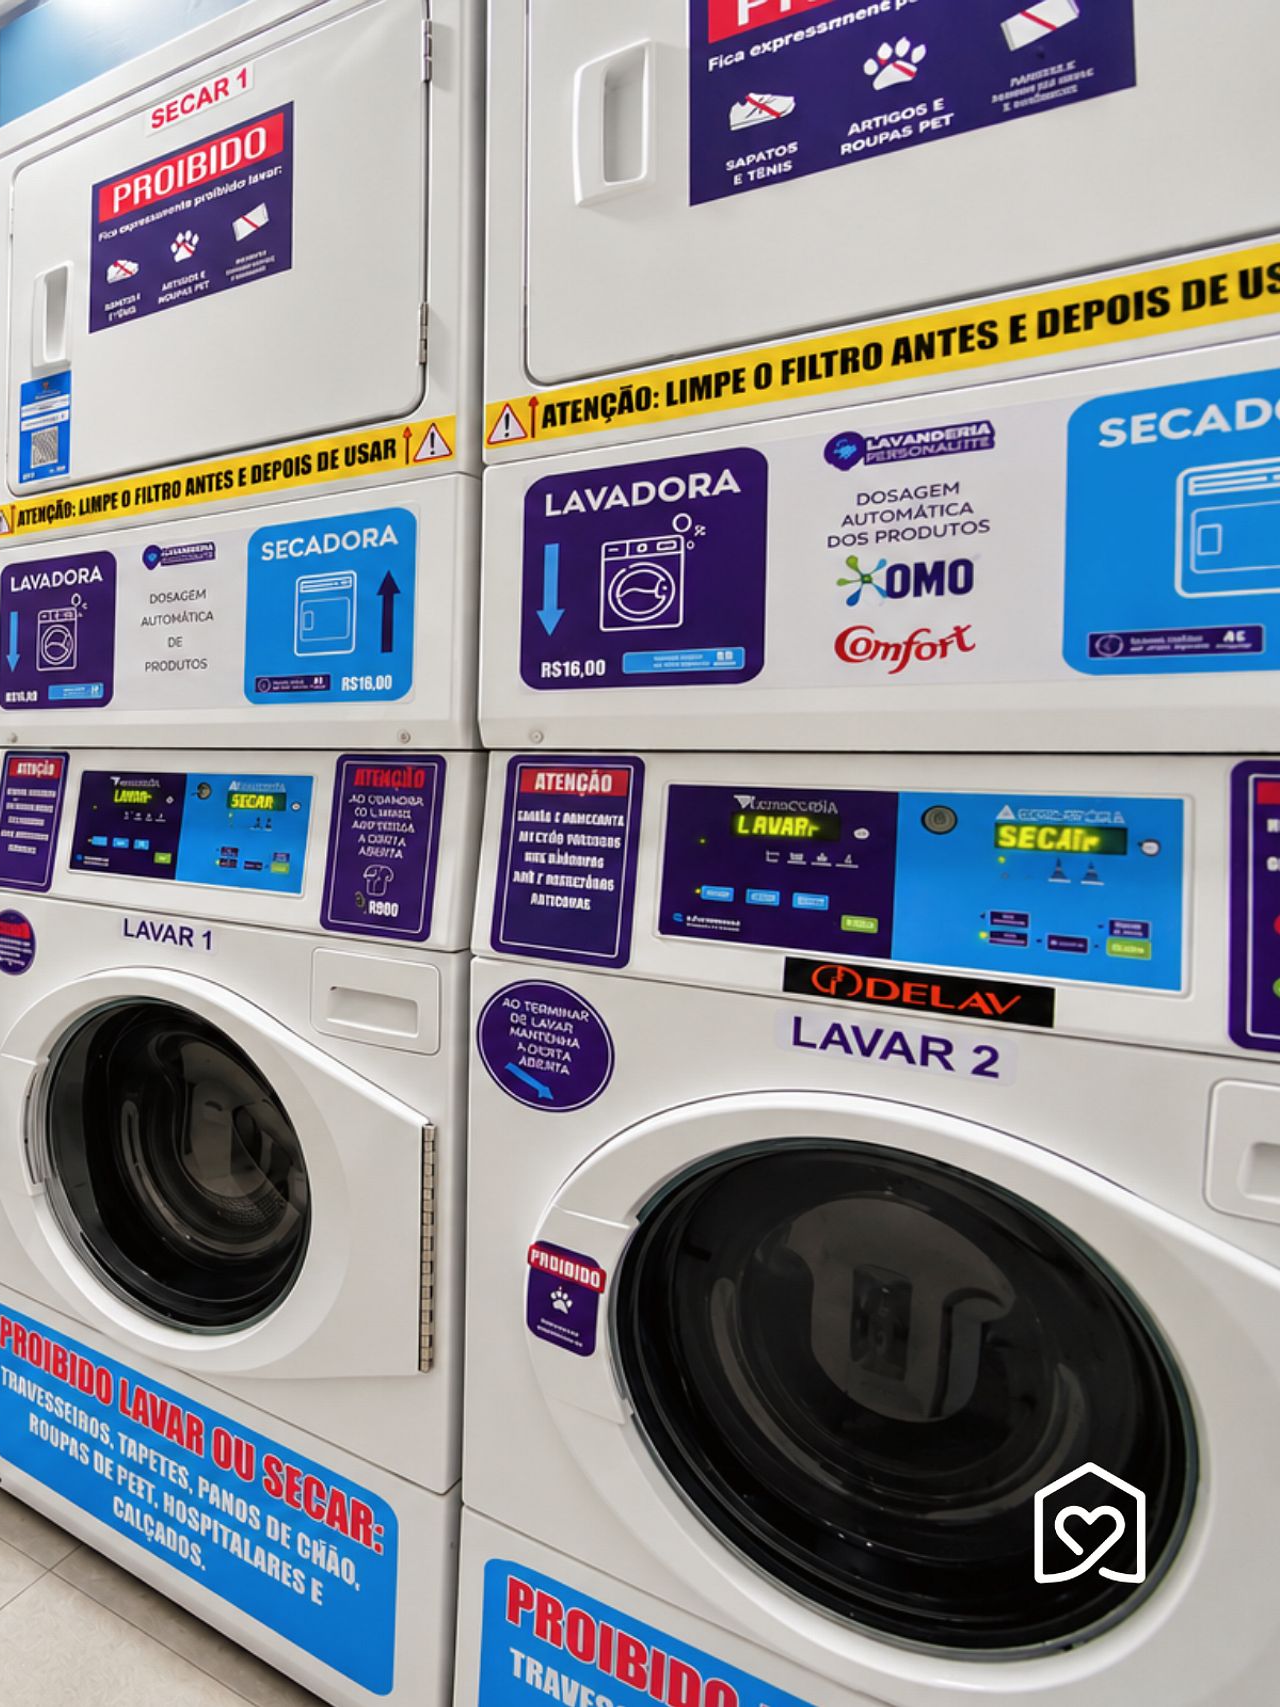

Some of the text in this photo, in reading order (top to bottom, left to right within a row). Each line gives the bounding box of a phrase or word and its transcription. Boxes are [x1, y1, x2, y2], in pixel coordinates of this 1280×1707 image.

[709, 51, 744, 72] Fica
[151, 68, 247, 128] SECAR 1
[848, 98, 944, 136] ARTIGOS E
[840, 113, 954, 155] ROUPAS PET
[113, 127, 266, 214] PROIBIDO
[726, 141, 798, 171] SAPATOS
[733, 173, 742, 186] E
[541, 384, 659, 430] ATENÇÃO:
[666, 367, 745, 408] LIMPE
[754, 362, 771, 391] O
[781, 341, 883, 386] FILTRO
[891, 319, 999, 367] ANTES
[1009, 313, 1027, 345] E
[1037, 285, 1170, 340] DEPOIS
[1181, 273, 1228, 312] DE
[1098, 397, 1280, 448] SECAD
[17, 438, 396, 527] ATENÇÃO: LIMPE O FILTRO ANTES E DEPOIS DE USAR
[545, 469, 741, 517] LAVADORA
[857, 481, 960, 506] DOSAGEM
[841, 502, 974, 527] AUTOMÁTICA
[261, 524, 398, 561] SECADORA
[827, 519, 991, 549] DOS PRODUTOS
[10, 566, 103, 592] LAVADORA
[149, 589, 206, 605] DOSAGEM
[886, 558, 974, 600] OMO
[141, 610, 214, 627] AUTOMÁTICA
[168, 637, 183, 648] DE
[834, 624, 976, 675] Comfort
[145, 658, 208, 672] PRODUTOS
[123, 918, 212, 950] LAVAR 1
[502, 998, 520, 1009] AO
[866, 977, 1021, 1016] DELAV
[531, 1017, 574, 1034] LAVAR
[792, 1016, 999, 1079] LAVAR 2
[0, 1314, 384, 1556] PROIBIDO LAVAR OU SECAR:
[29, 1412, 90, 1466] ROUPAS
[94, 1449, 114, 1481] DE
[163, 1491, 306, 1595] HOSPITALARES
[311, 1577, 324, 1606] E
[198, 1476, 261, 1531] PANOS
[267, 1515, 292, 1549] DE
[113, 1495, 206, 1571] CALÇADOS.
